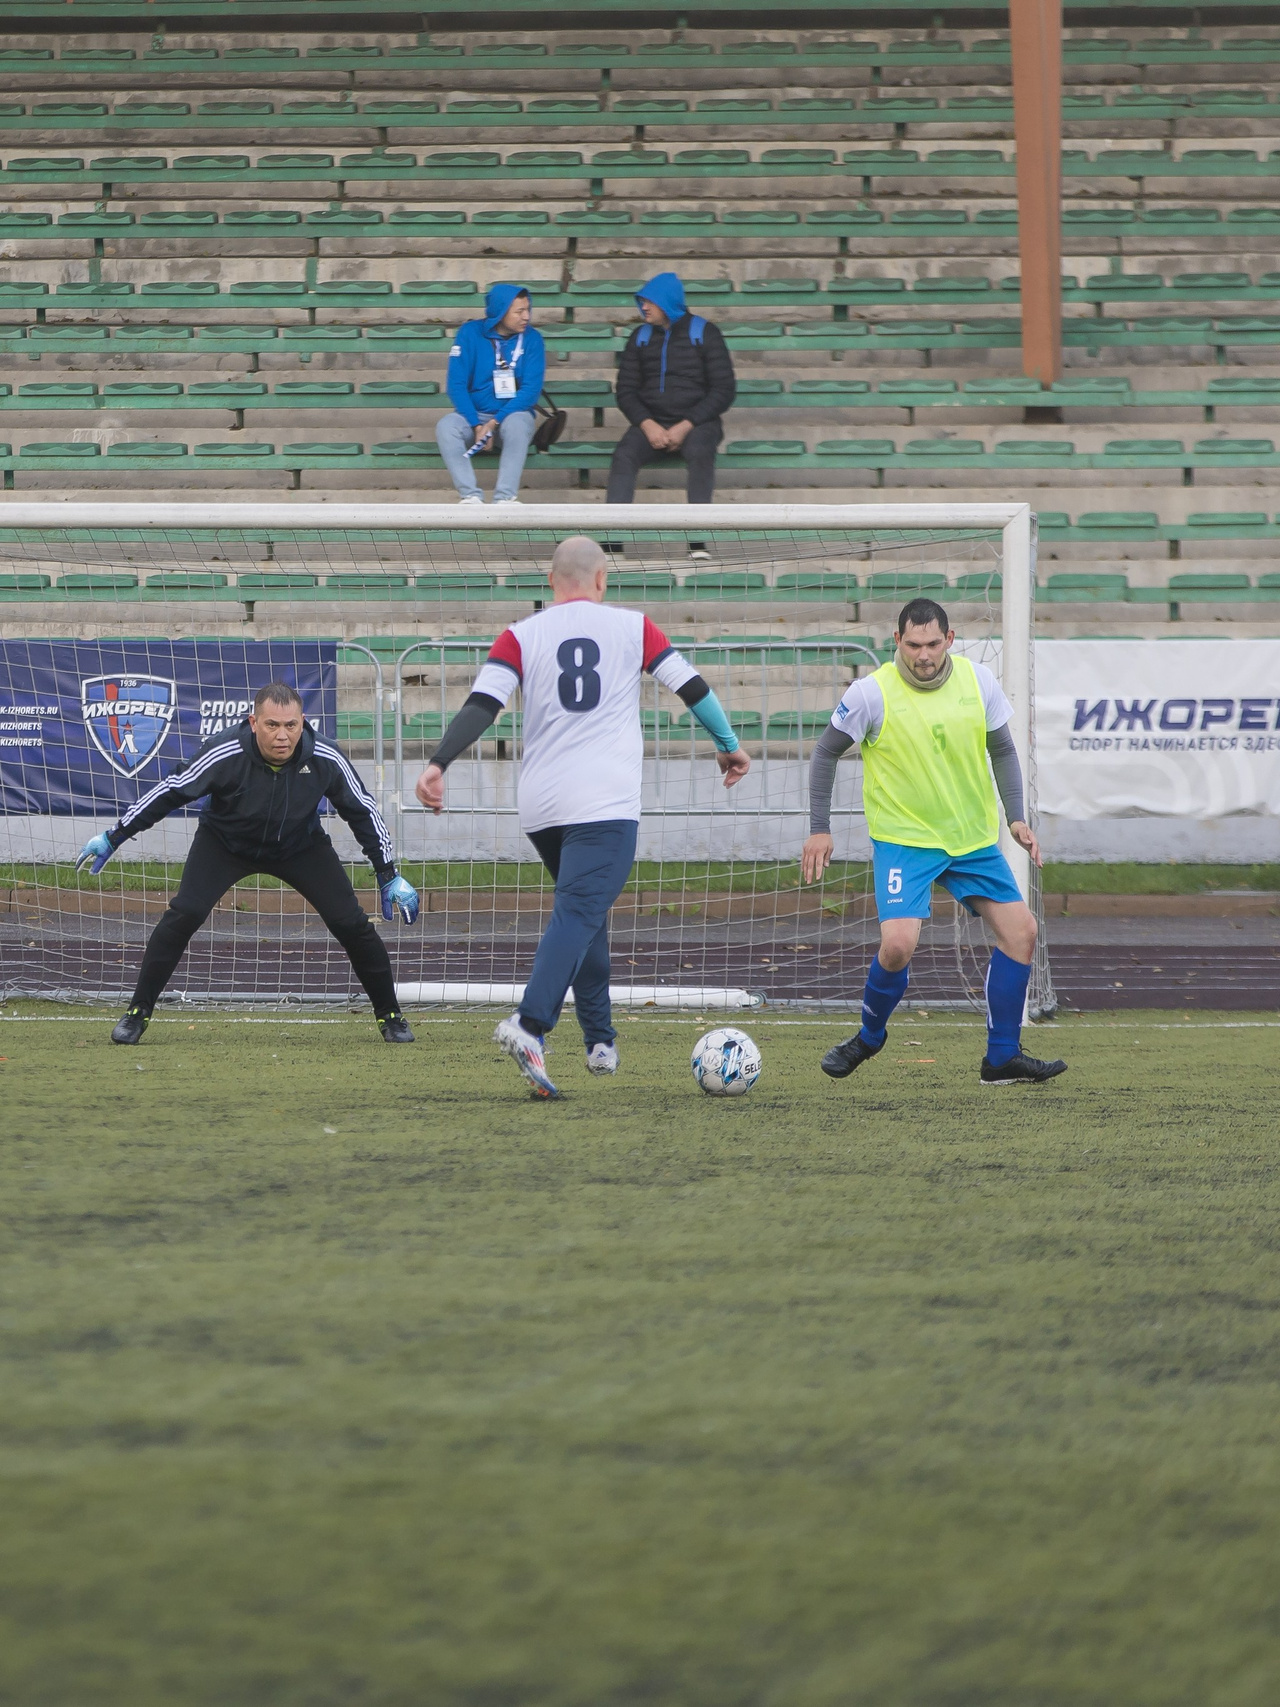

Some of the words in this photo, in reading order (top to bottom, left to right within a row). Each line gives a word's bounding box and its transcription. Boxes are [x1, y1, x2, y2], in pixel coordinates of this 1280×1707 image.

[557, 638, 601, 713] 8
[82, 701, 175, 721] ИЖОРЕЦ
[1073, 699, 1280, 731] ИЖОРЕ
[932, 723, 946, 755] 5
[1070, 737, 1126, 751] СПОРТ
[1129, 738, 1238, 751] НАЧИНАЕТСЯ
[1243, 737, 1280, 753] ЗДЕ
[888, 868, 902, 895] 5
